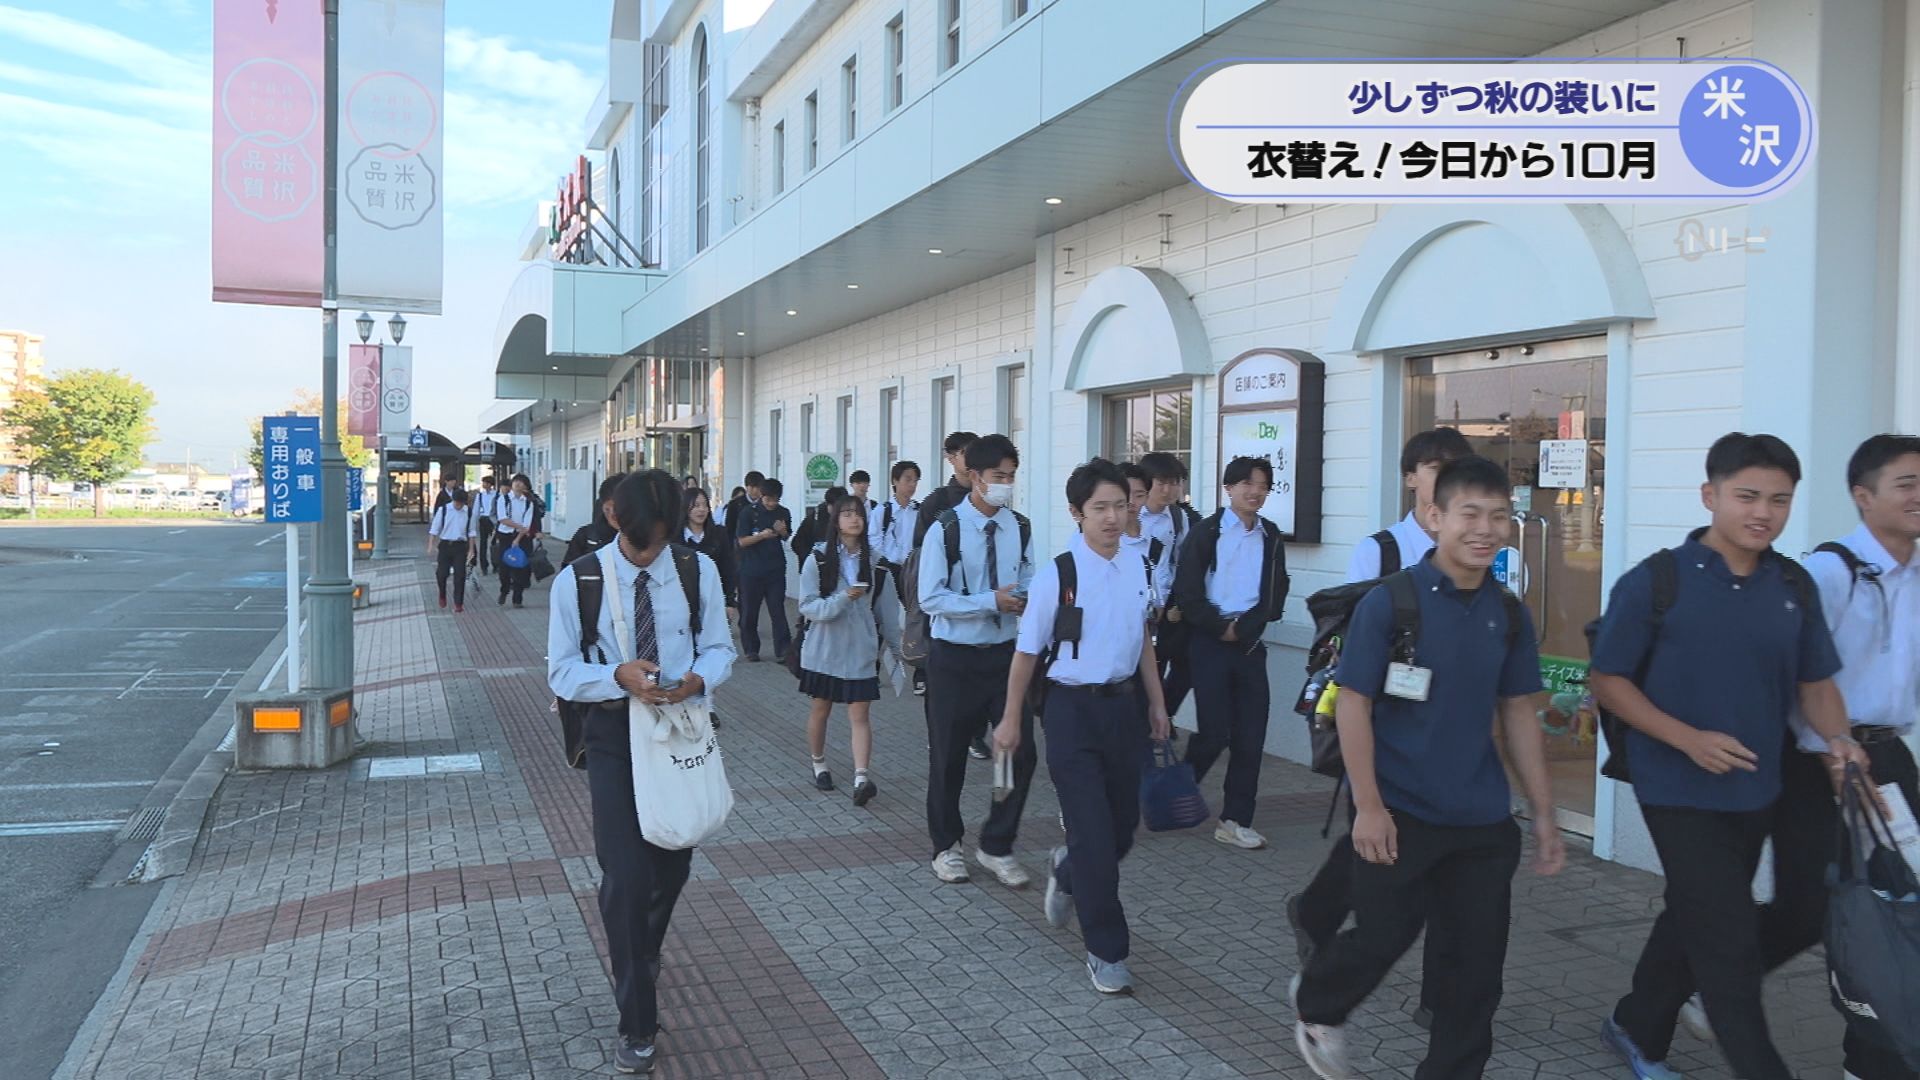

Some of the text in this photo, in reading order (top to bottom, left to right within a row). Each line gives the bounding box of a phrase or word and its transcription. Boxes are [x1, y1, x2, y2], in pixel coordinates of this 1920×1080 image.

[273, 152, 296, 203] 米沢
[394, 163, 415, 211] 米沢
[270, 426, 291, 518] 専用おりば
[294, 427, 315, 491] 一般車
